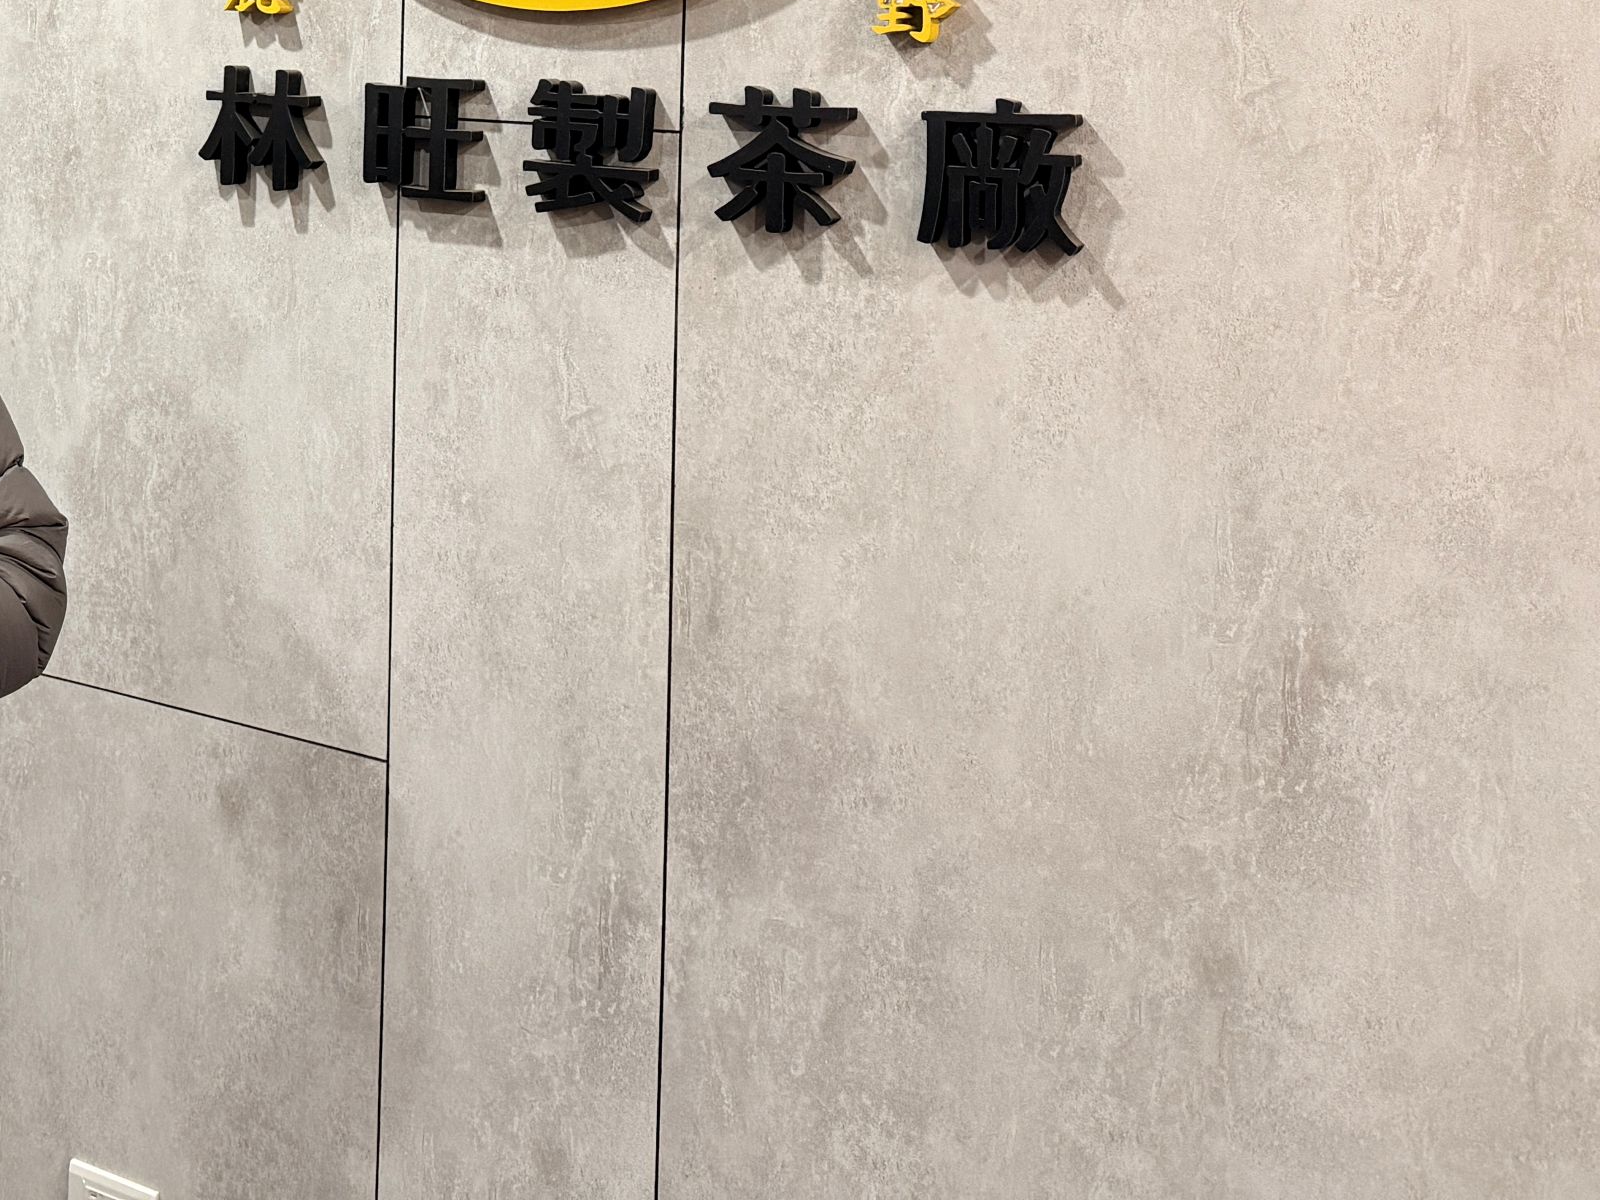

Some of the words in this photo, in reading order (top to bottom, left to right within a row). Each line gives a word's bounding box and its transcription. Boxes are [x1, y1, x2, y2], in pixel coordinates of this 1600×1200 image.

[198, 63, 1087, 257] 林旺製茶廠
